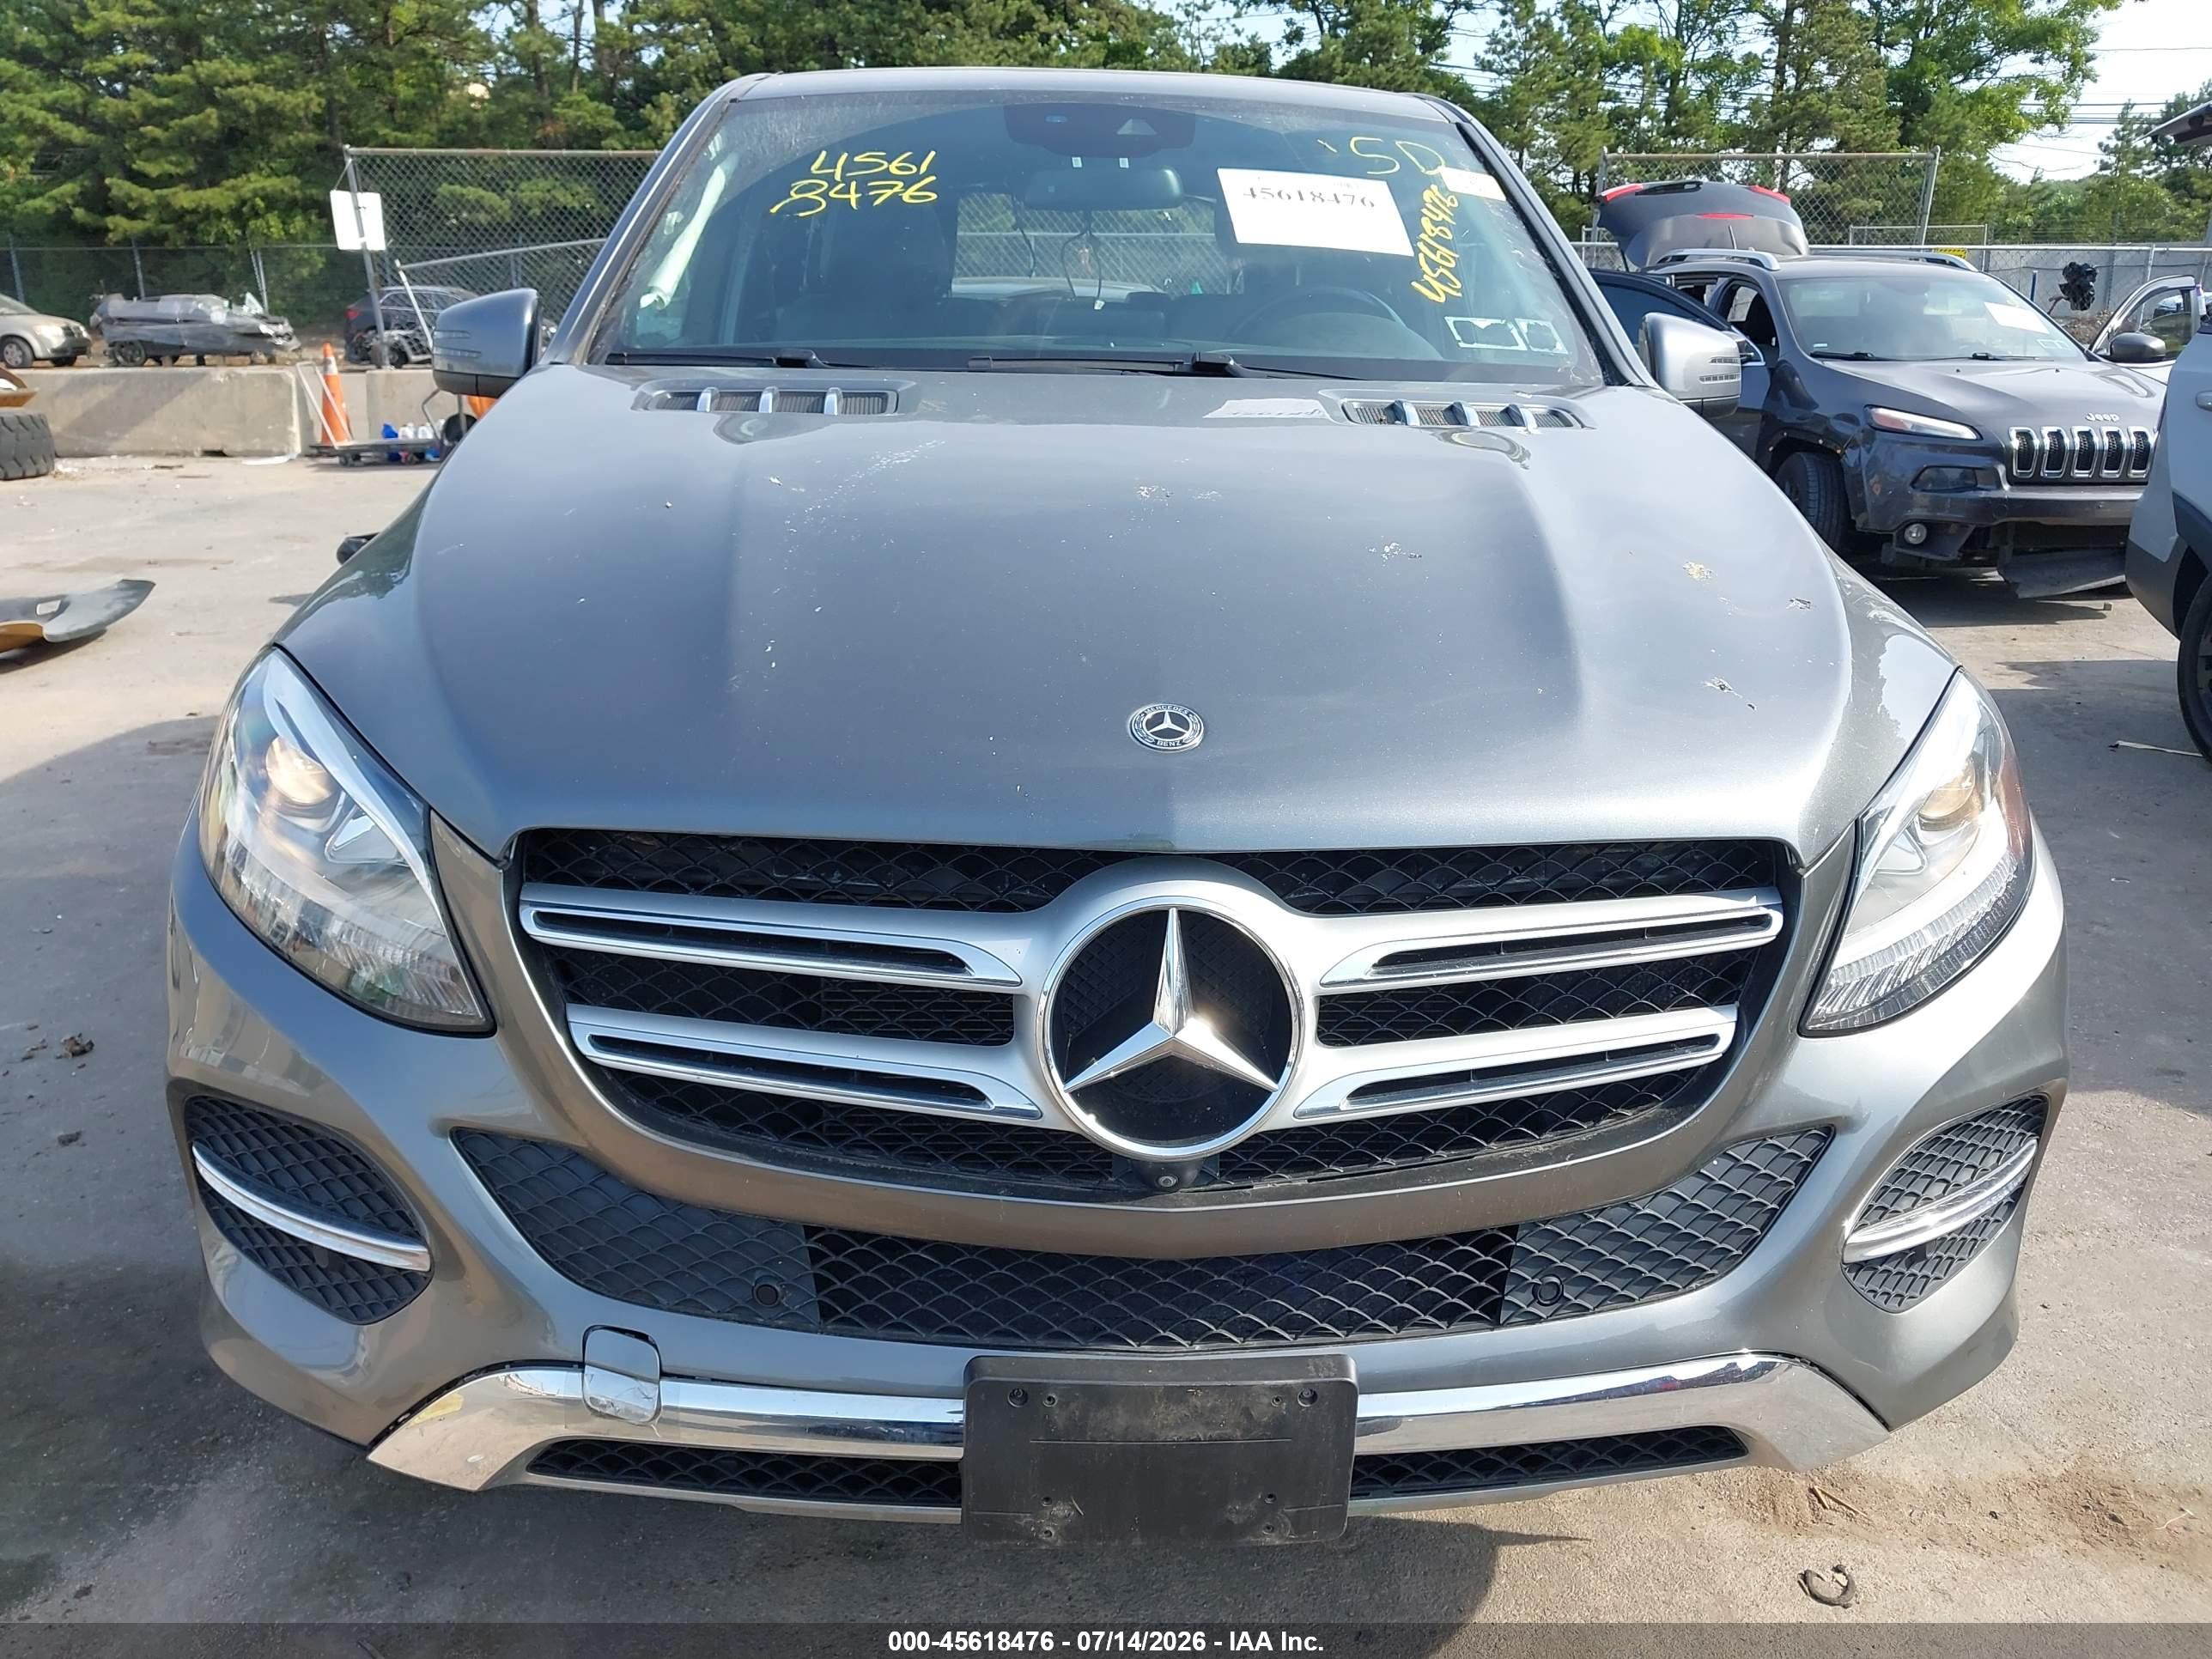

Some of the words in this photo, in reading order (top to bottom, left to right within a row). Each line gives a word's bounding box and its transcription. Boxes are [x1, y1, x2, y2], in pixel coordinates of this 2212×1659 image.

[810, 149, 936, 182] 4561
[769, 175, 939, 217] 8476
[1243, 185, 1376, 209] 45618476
[2085, 412, 2120, 422] Jeep
[1144, 705, 1189, 715] MERCEDES
